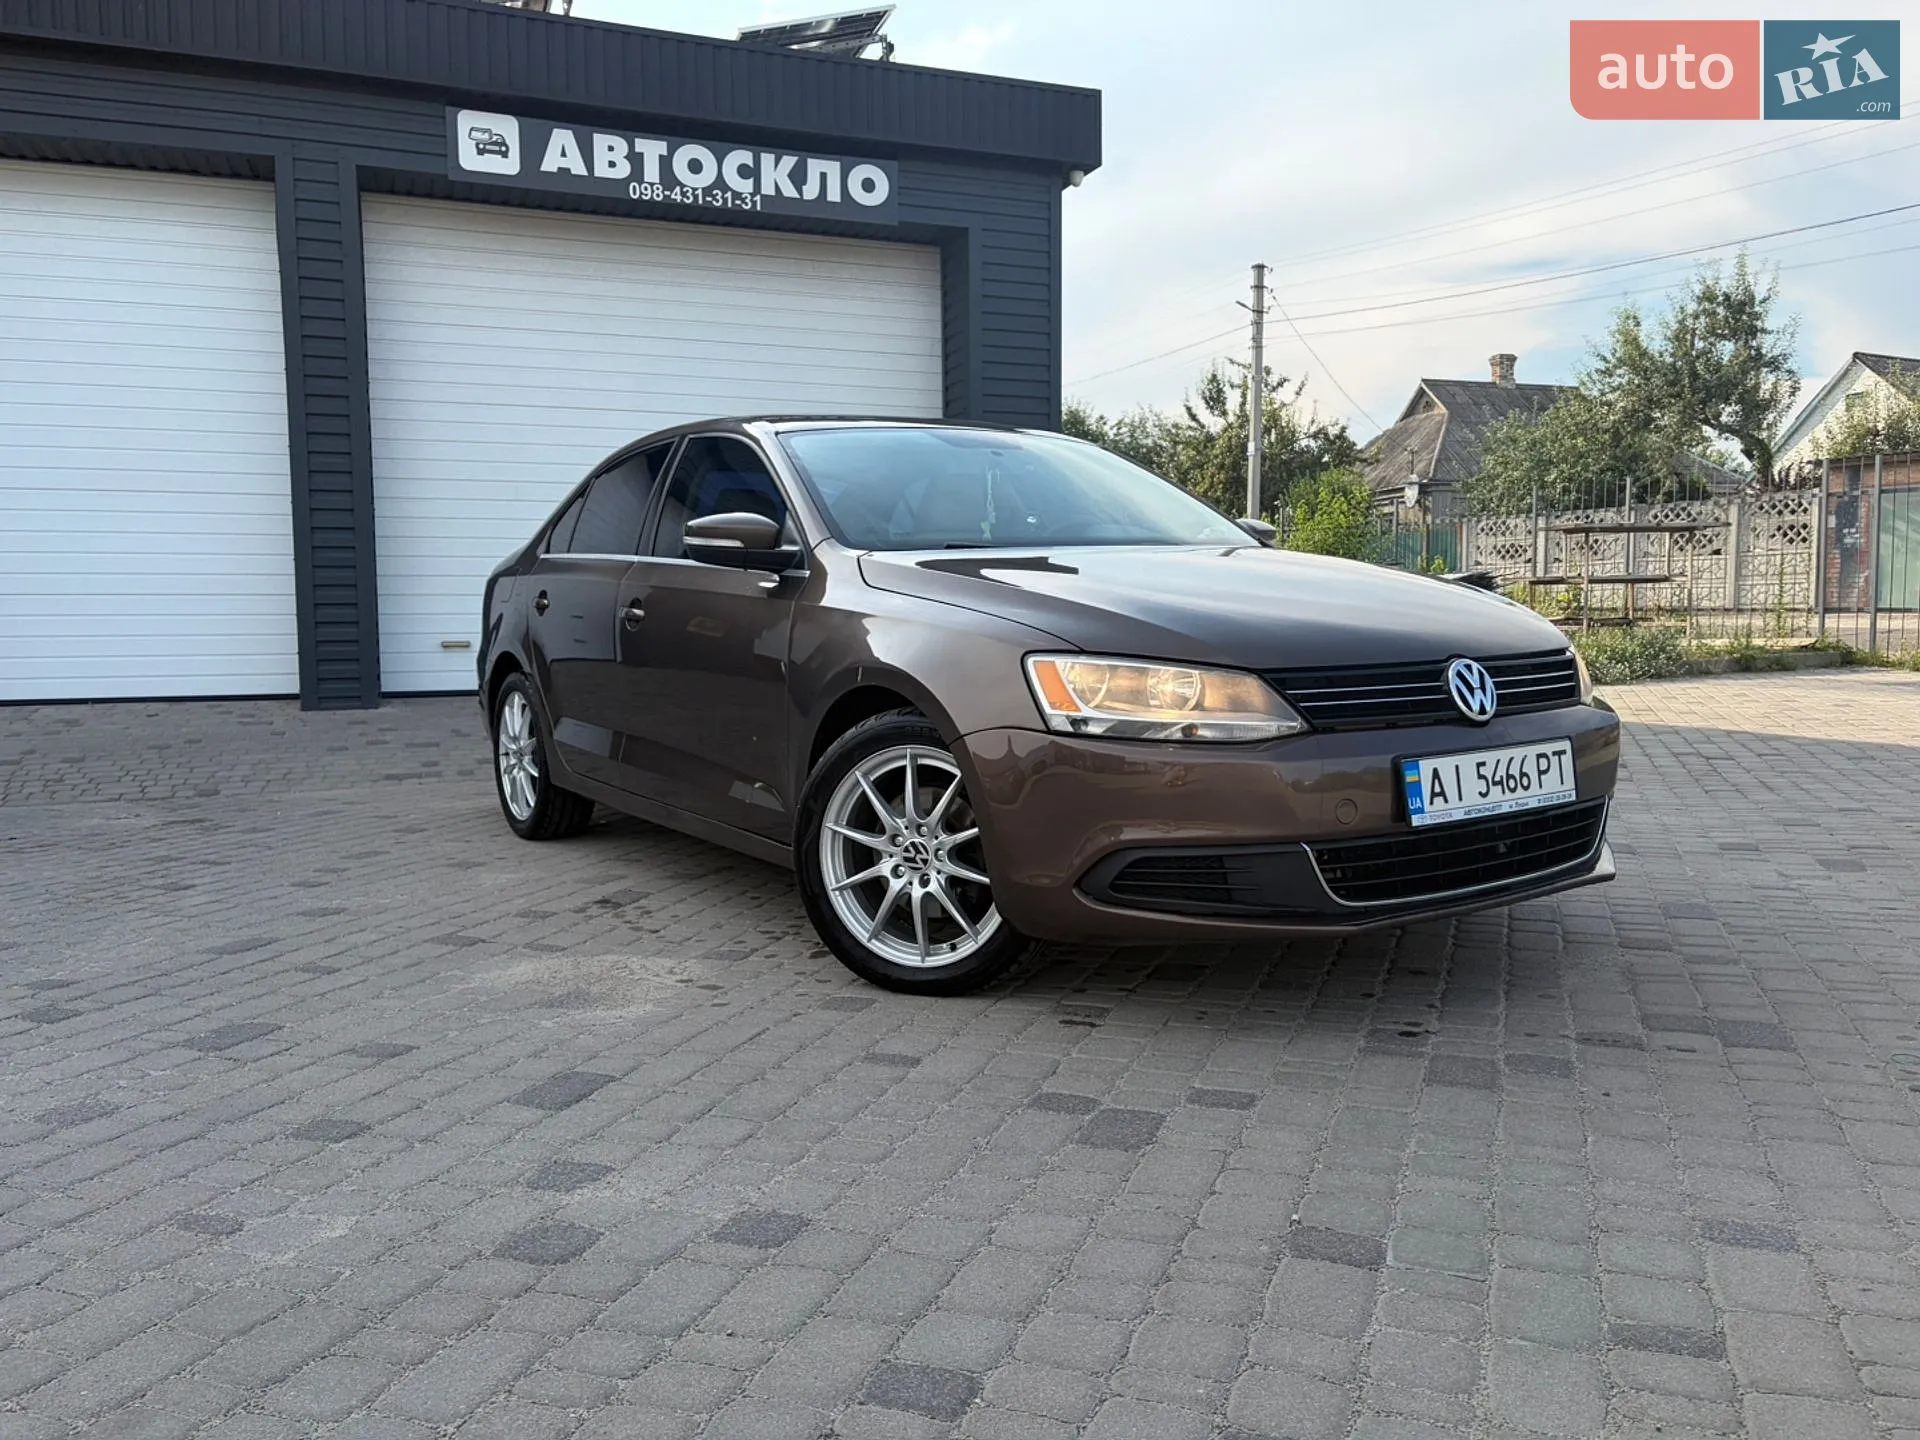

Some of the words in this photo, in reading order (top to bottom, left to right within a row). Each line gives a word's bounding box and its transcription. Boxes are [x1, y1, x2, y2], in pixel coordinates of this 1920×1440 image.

[540, 128, 890, 207] АВТОСКЛО
[629, 181, 763, 212] 098-431-31-31
[1429, 765, 1463, 806] AI
[1475, 754, 1532, 799] 5466
[1535, 749, 1567, 790] PT
[1409, 797, 1423, 810] UA
